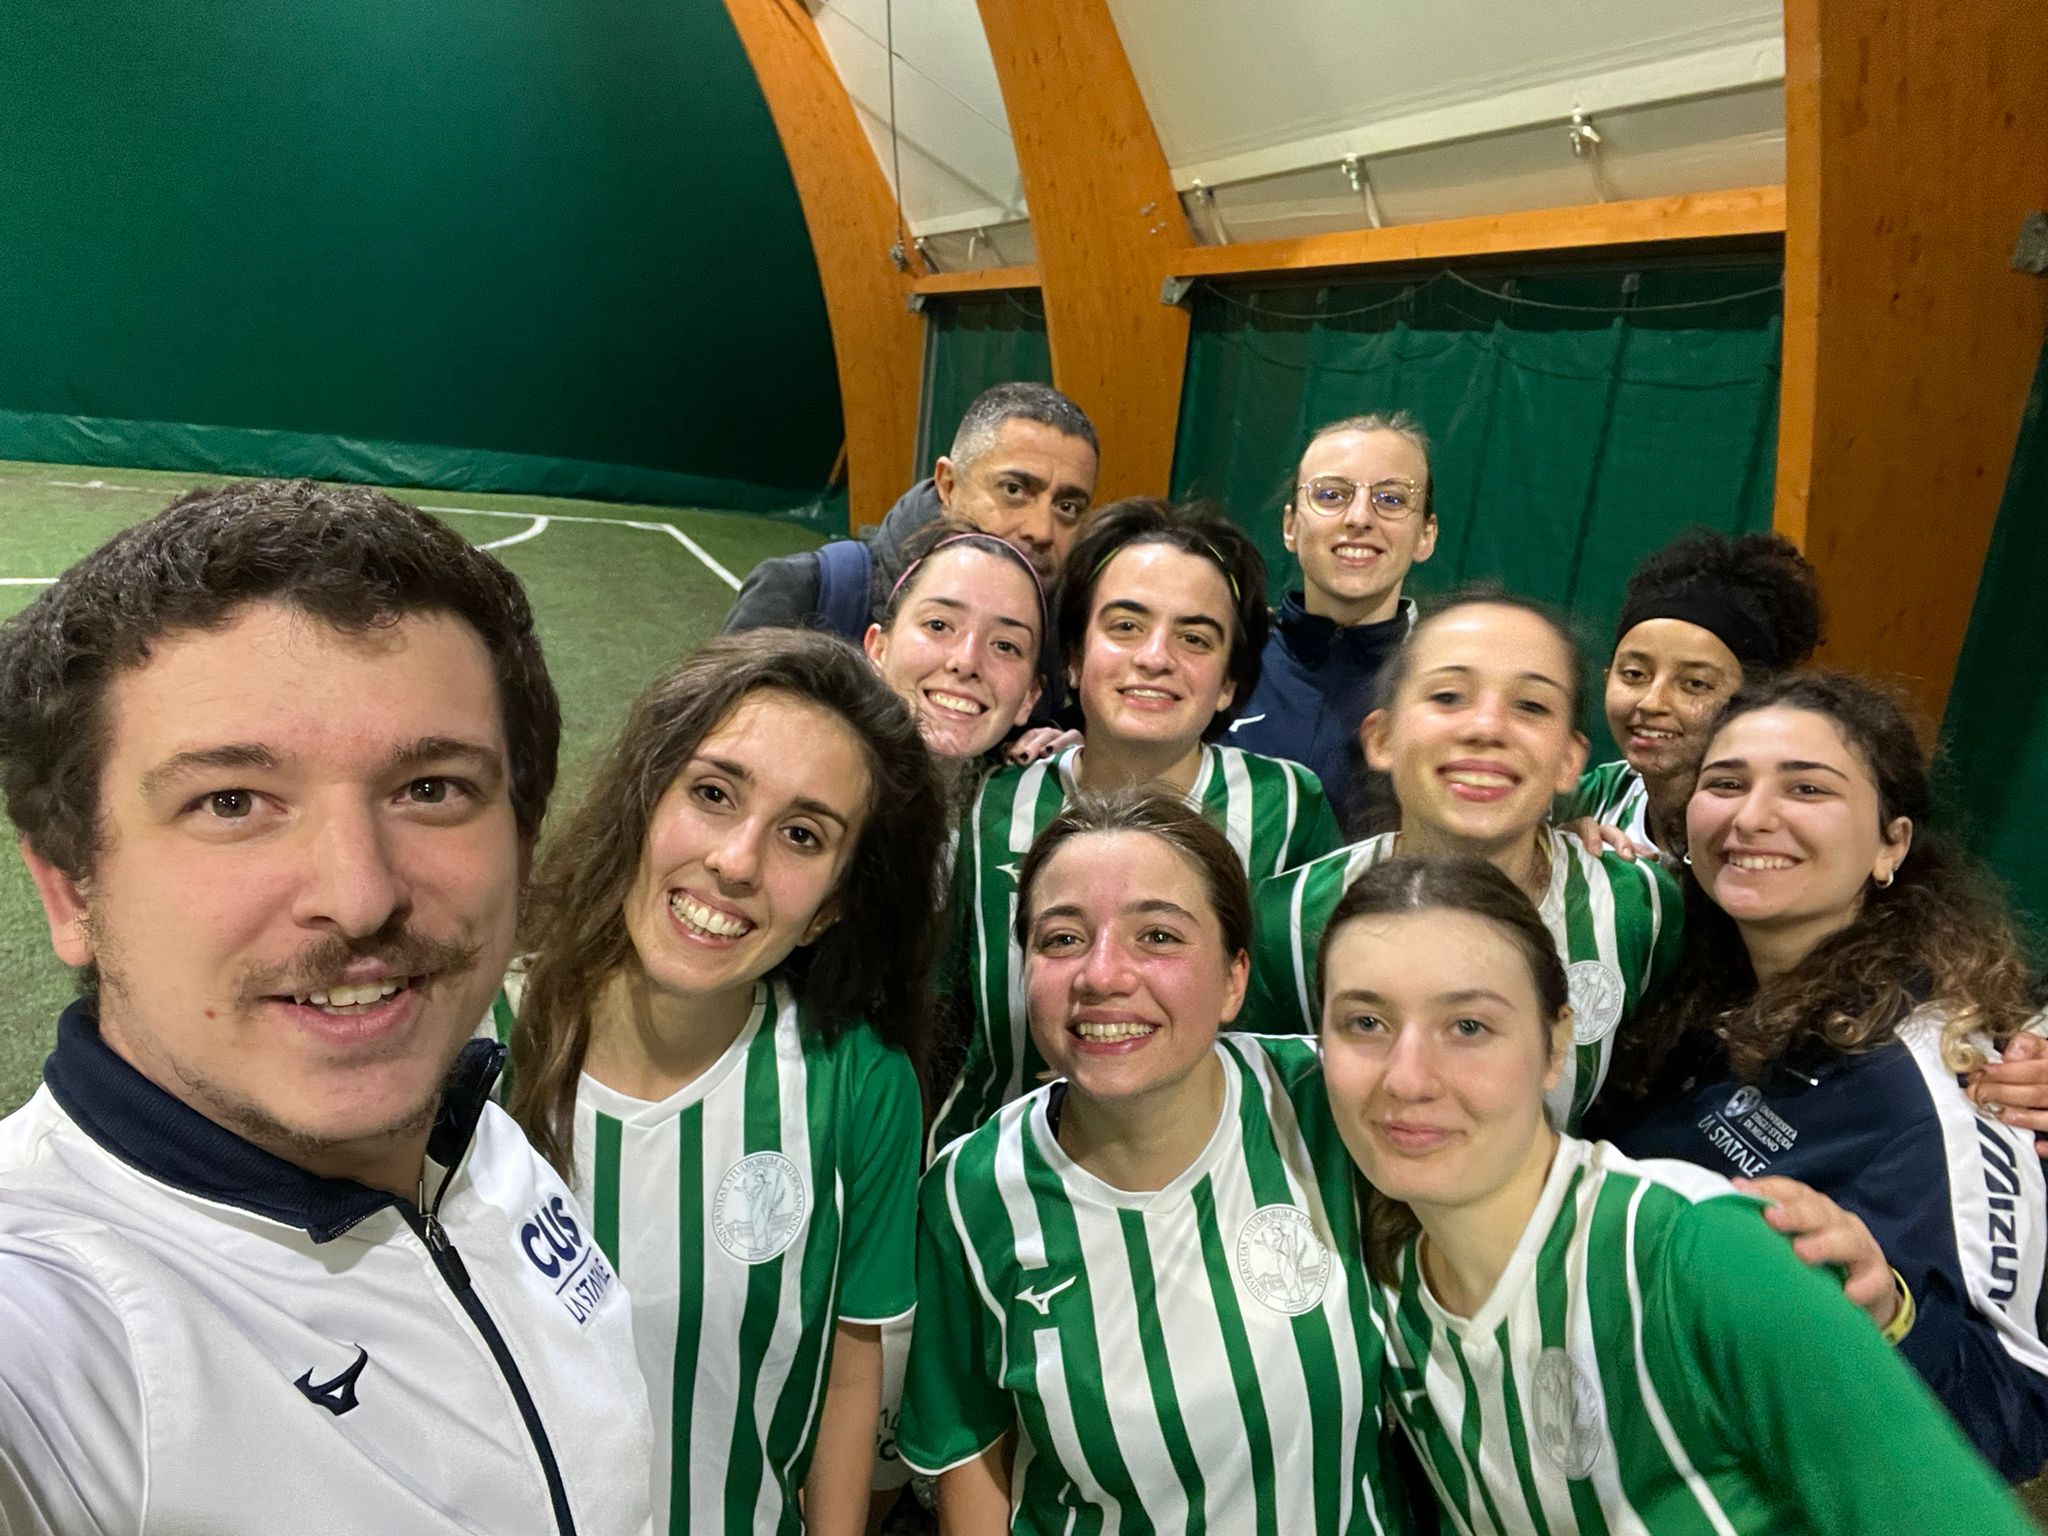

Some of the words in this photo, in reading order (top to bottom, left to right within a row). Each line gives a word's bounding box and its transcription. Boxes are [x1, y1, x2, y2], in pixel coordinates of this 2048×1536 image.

[1698, 1113, 1717, 1134] LA
[1708, 1126, 1767, 1178] STATALE
[1751, 1124, 1780, 1153] MILANO
[1768, 1127, 1794, 1150] STUDI
[520, 1196, 583, 1279] CUS
[564, 1296, 591, 1325] LA
